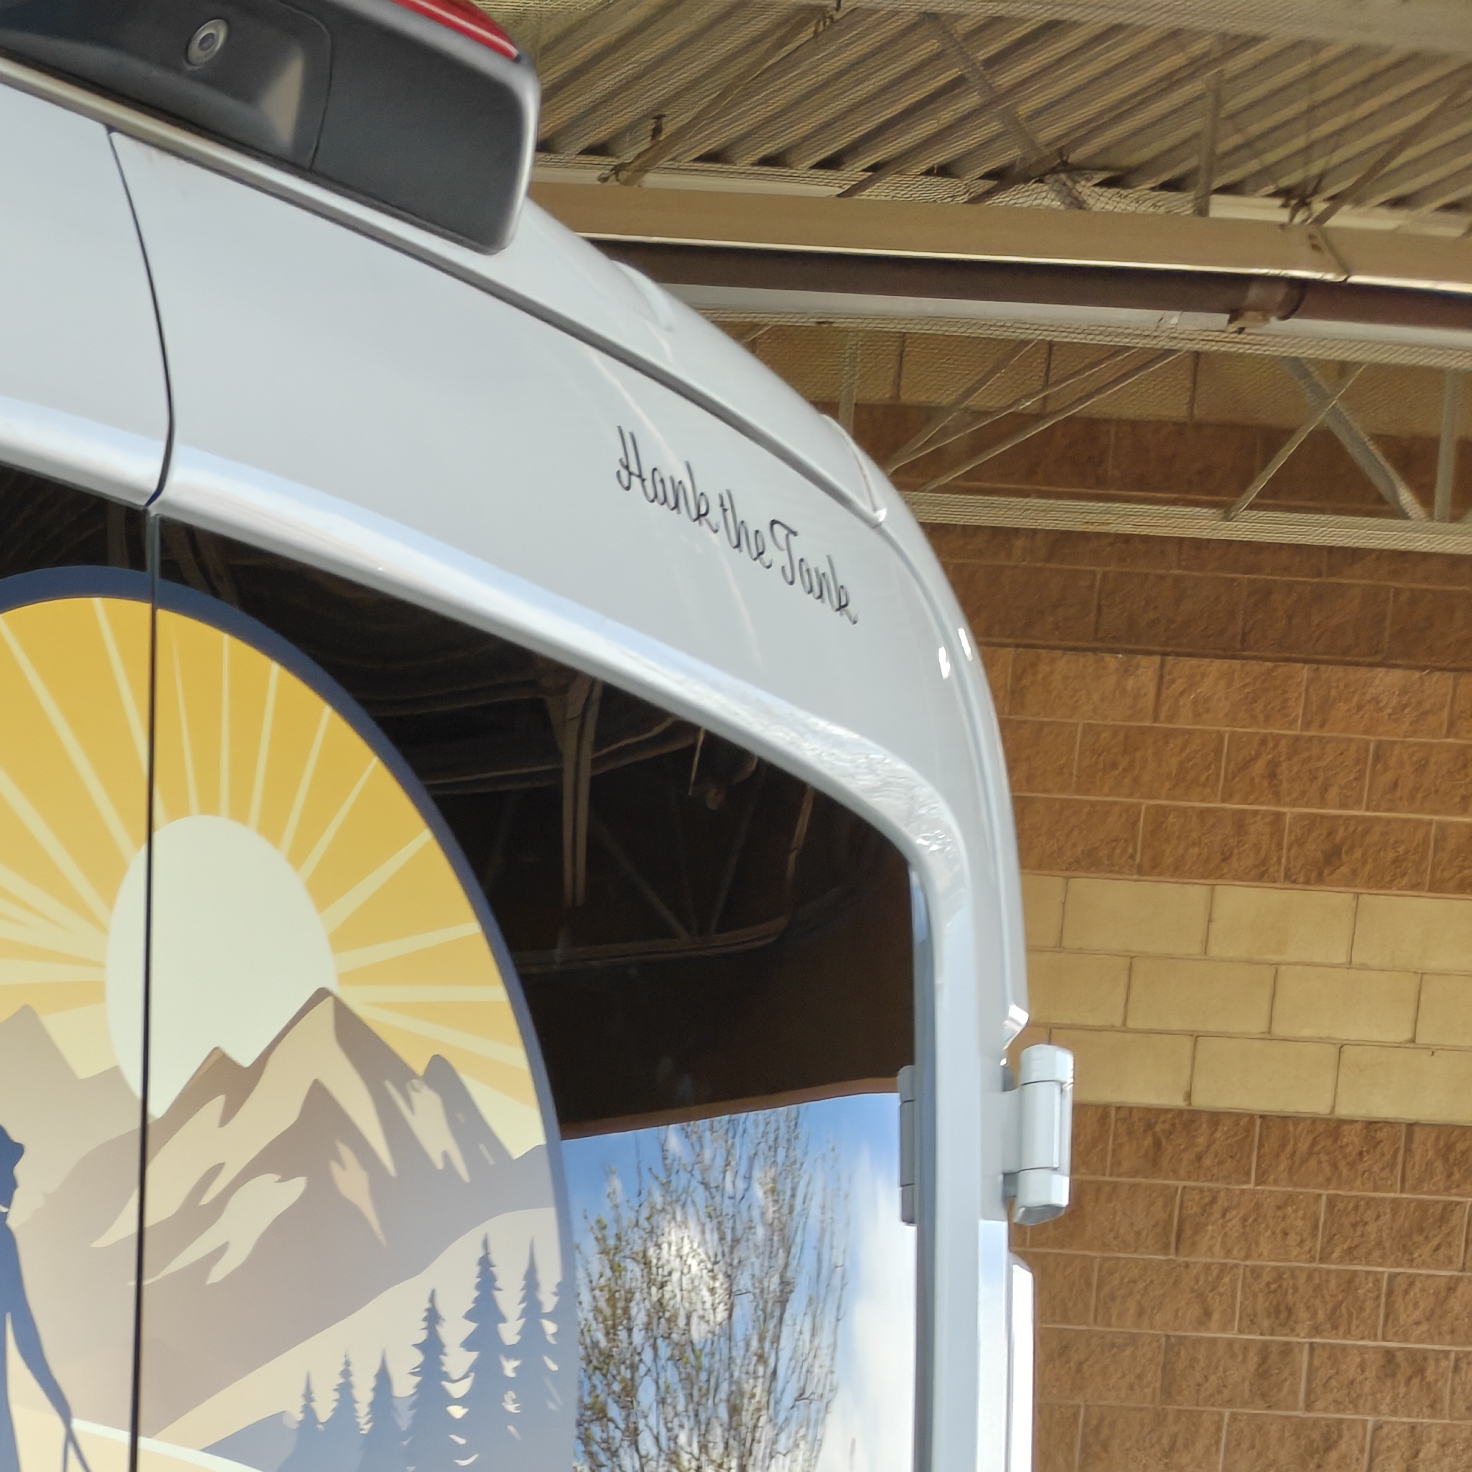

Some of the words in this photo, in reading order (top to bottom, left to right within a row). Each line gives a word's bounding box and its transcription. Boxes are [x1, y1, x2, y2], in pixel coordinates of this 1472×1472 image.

[616, 425, 719, 533] Hank
[718, 489, 772, 569] the
[769, 519, 859, 625] Tank
